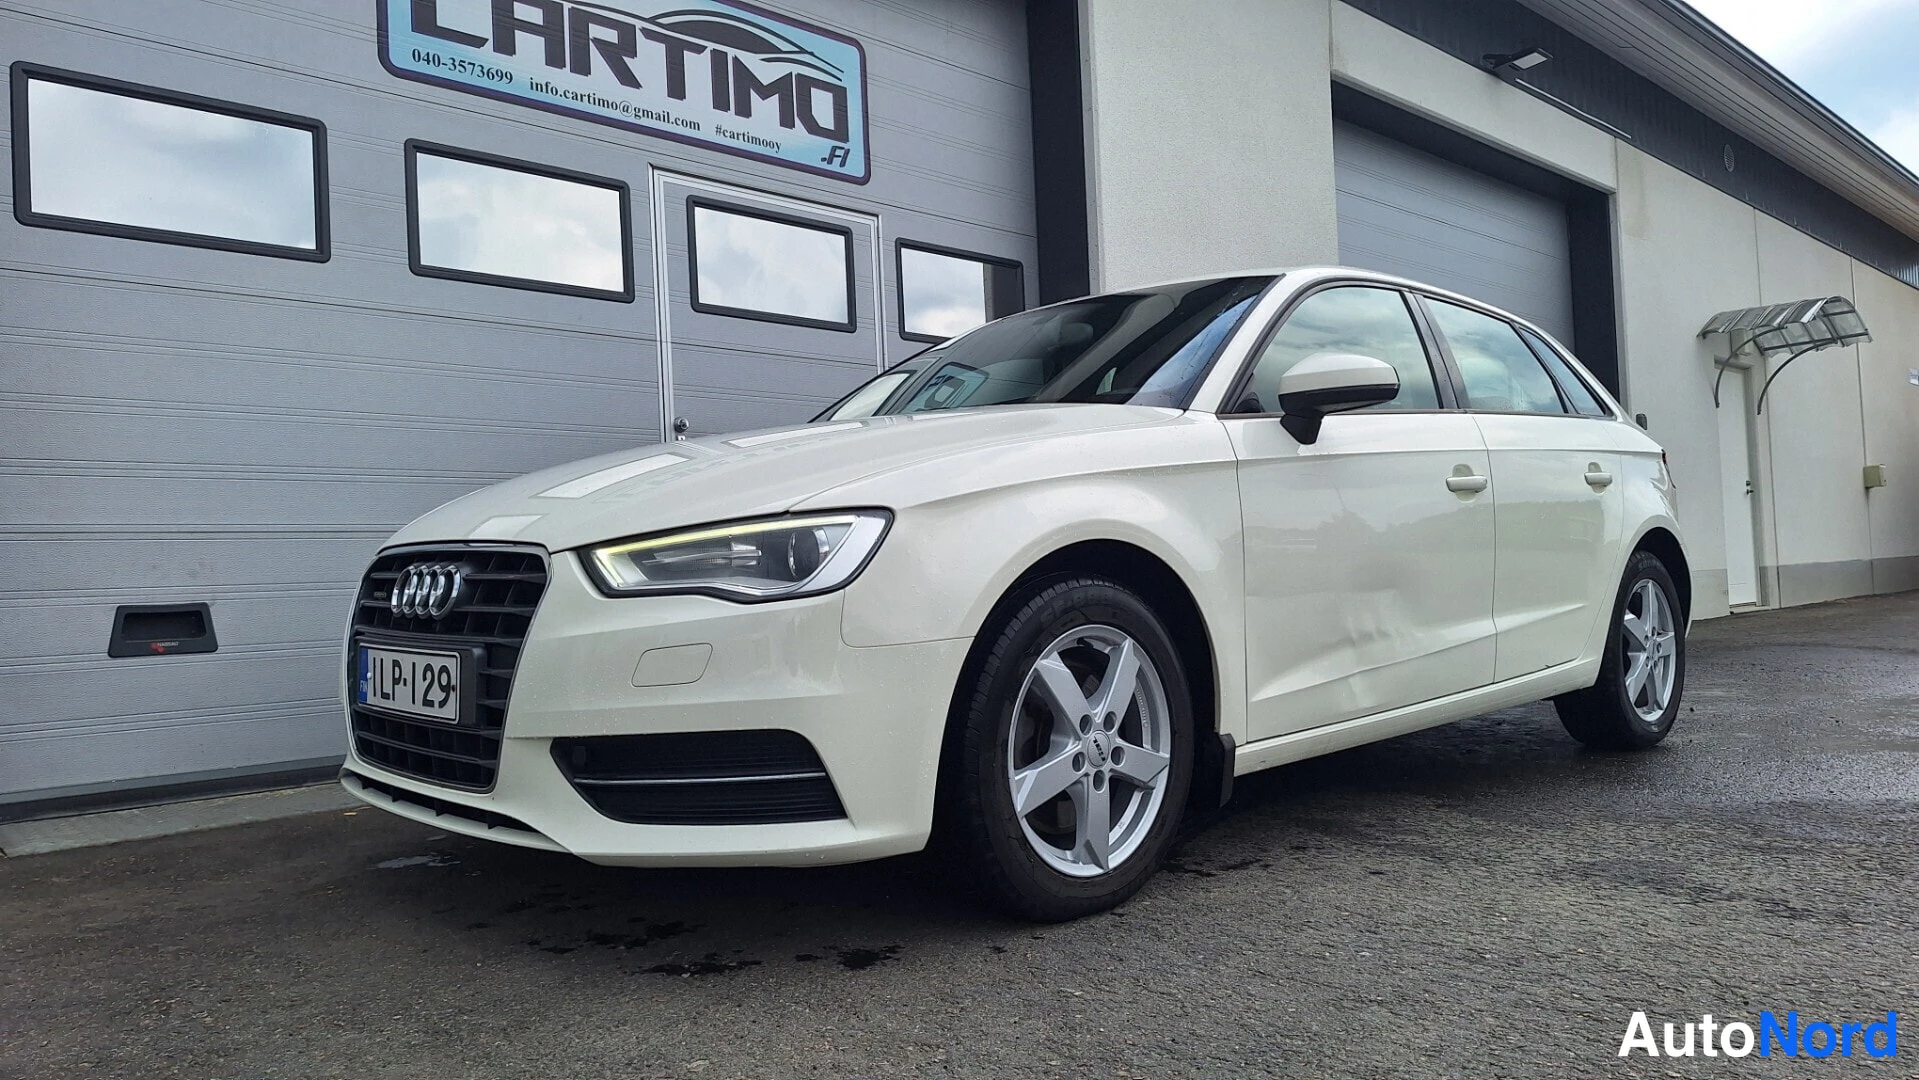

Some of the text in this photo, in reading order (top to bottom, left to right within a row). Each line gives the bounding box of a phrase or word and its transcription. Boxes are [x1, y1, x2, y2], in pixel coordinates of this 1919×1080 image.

[411, 48, 782, 153] 040-3573699 info.cartimo@gmail.com #cartimooy
[373, 657, 452, 709] ILP-129
